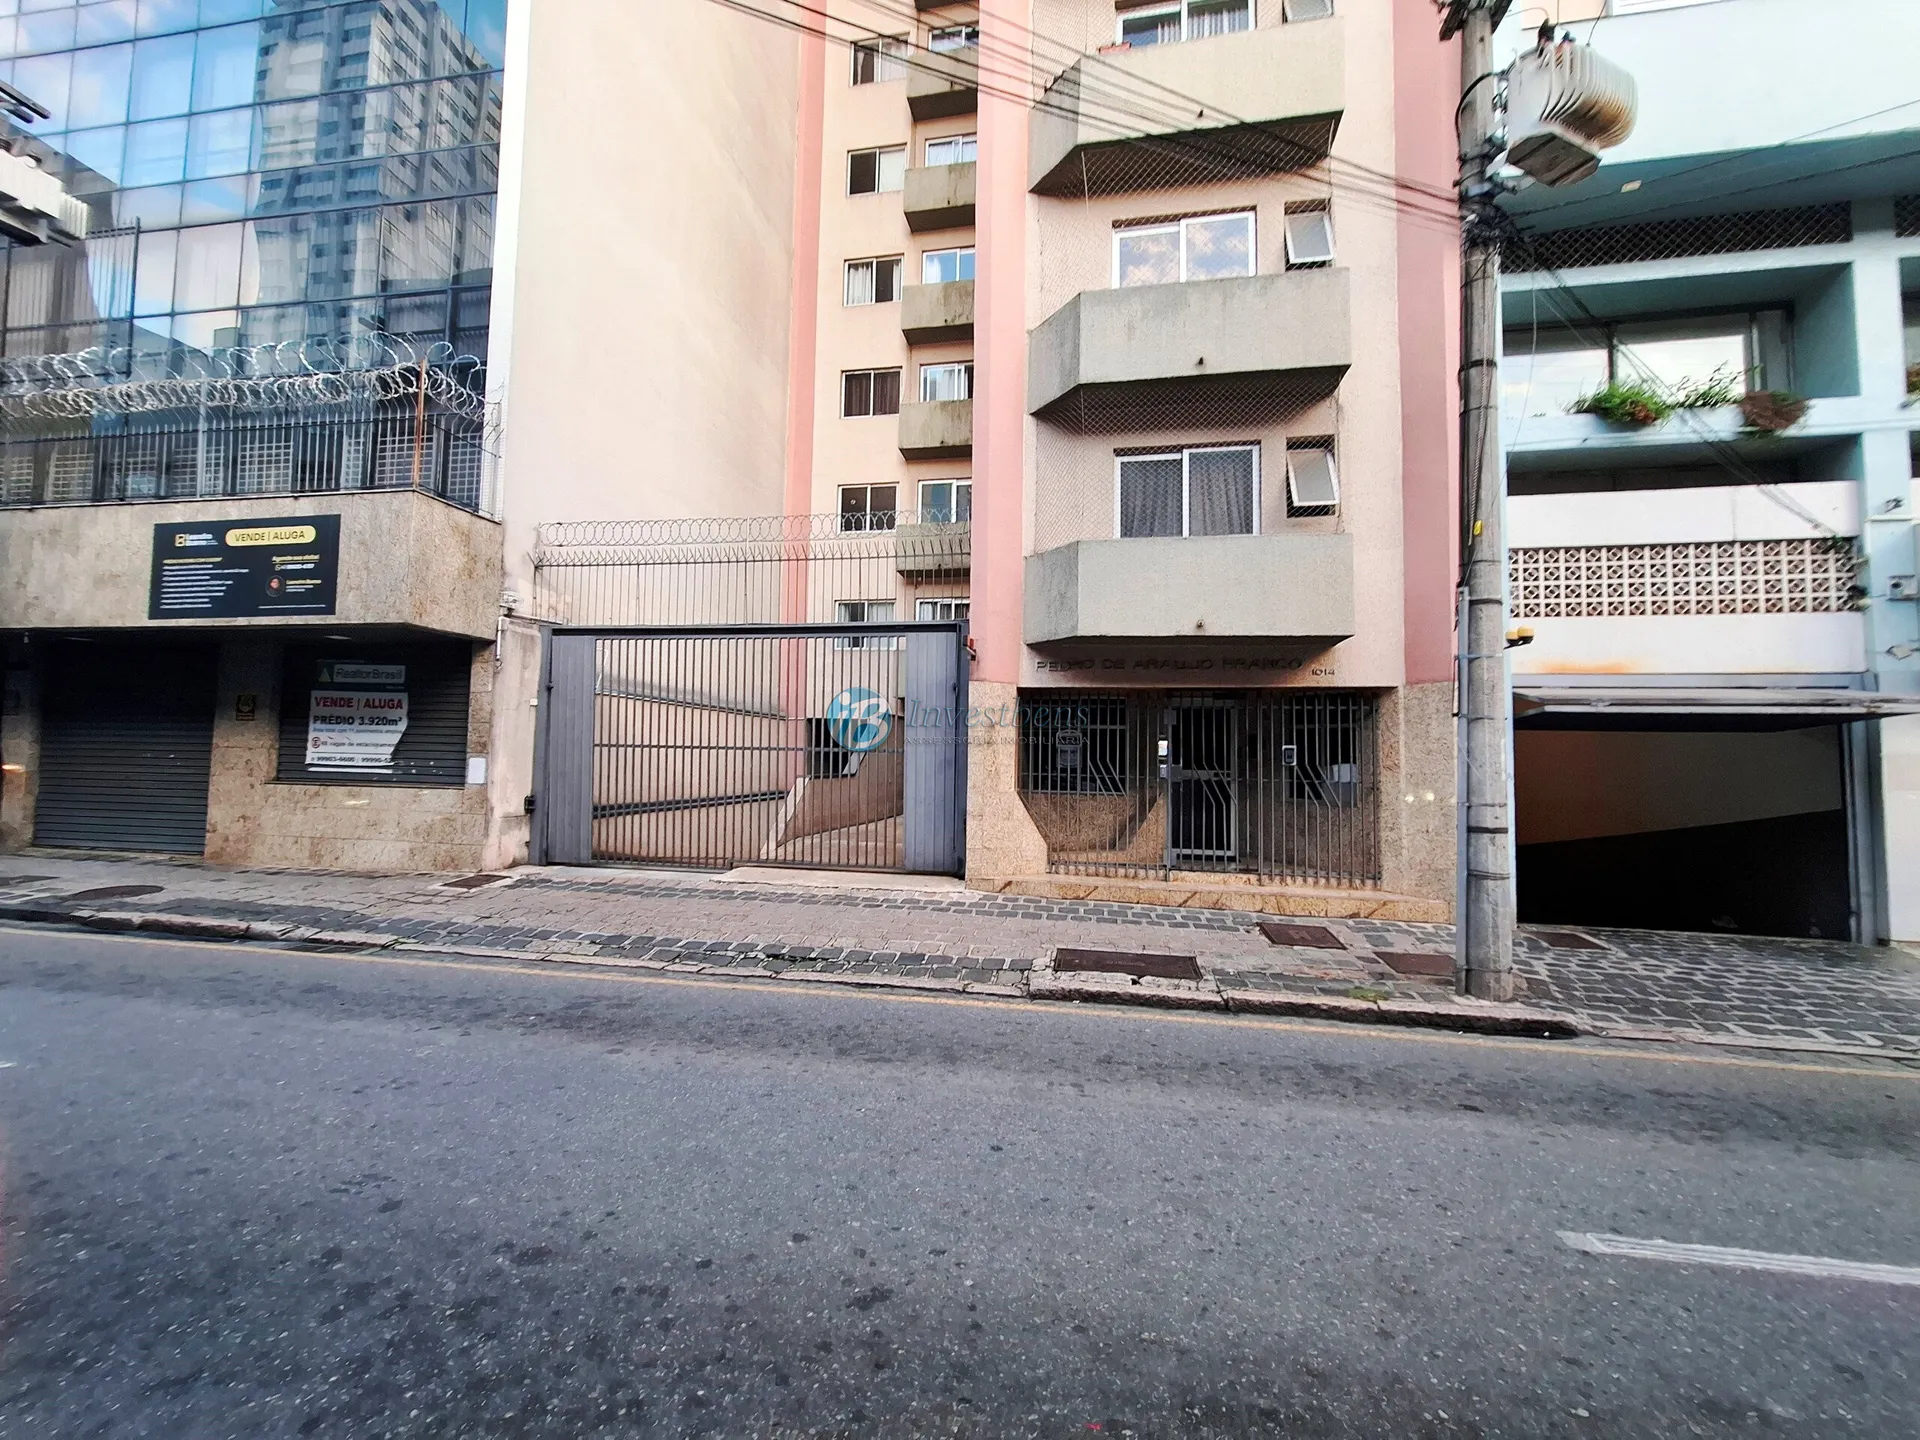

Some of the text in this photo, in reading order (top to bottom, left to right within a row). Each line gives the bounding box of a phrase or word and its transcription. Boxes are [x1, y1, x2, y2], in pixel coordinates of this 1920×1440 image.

[235, 532, 265, 542] VENDE
[272, 530, 305, 540] ALUGA
[1036, 659, 1096, 671] PEDRO
[1102, 658, 1125, 670] DE
[1311, 668, 1335, 676] 1014
[314, 696, 354, 708] VENDE
[363, 697, 403, 710] ALUGA
[313, 713, 355, 726] PRÉDIO
